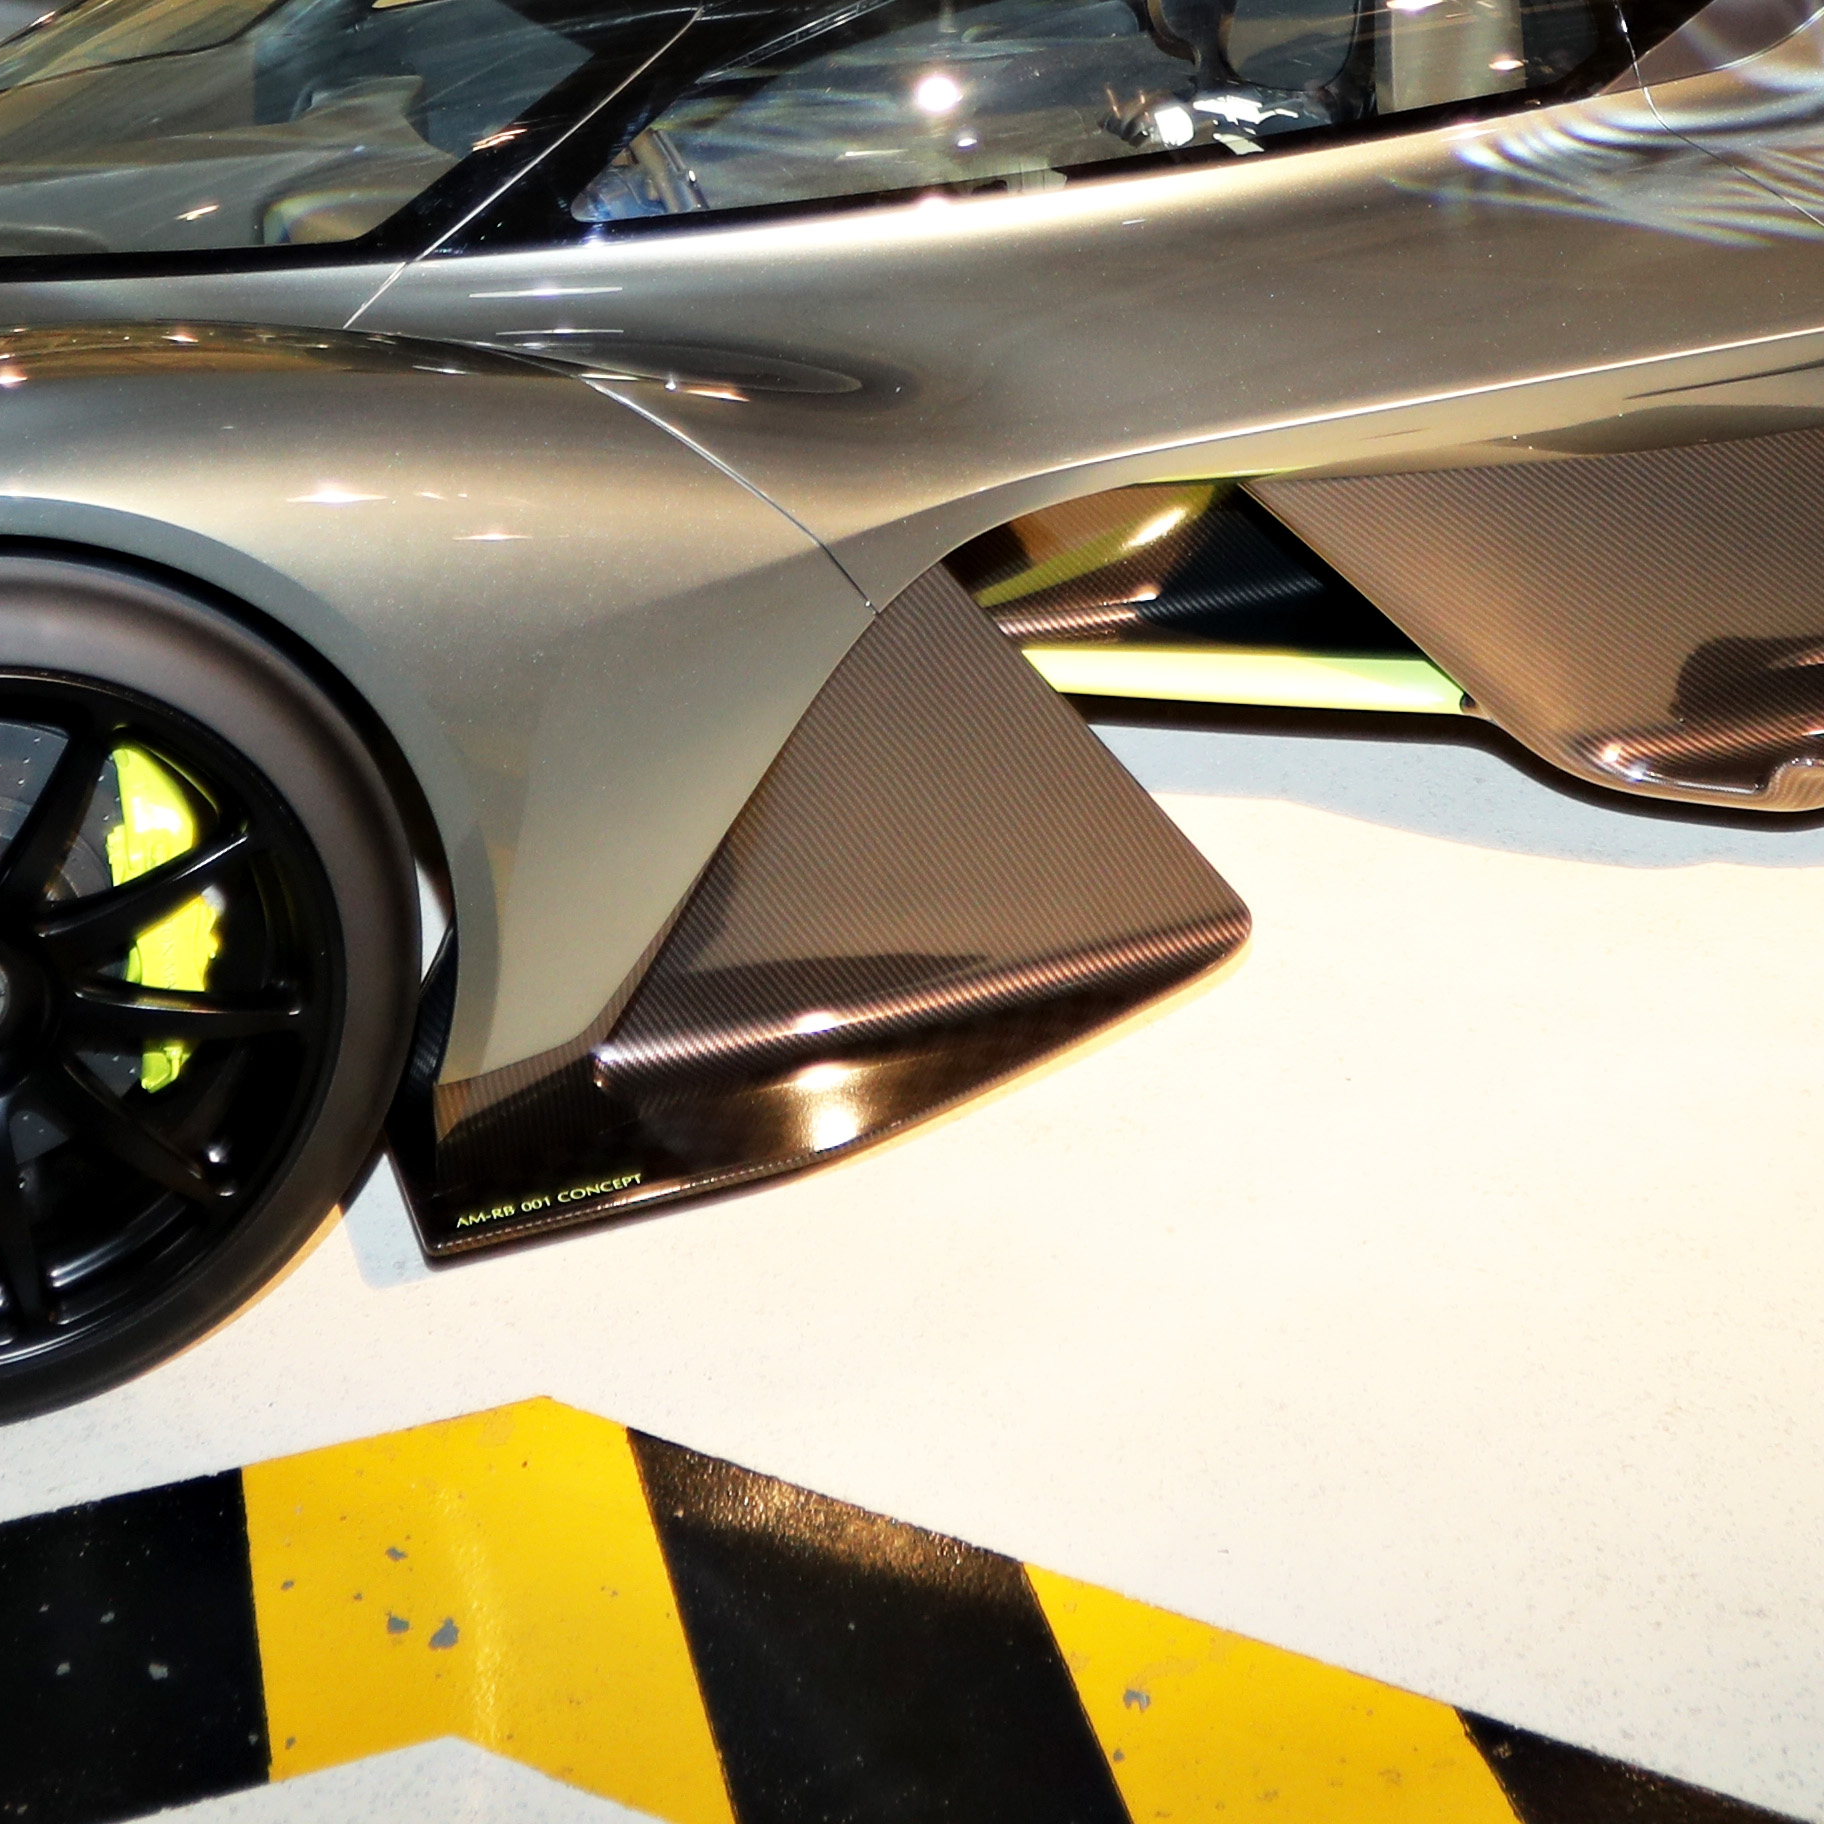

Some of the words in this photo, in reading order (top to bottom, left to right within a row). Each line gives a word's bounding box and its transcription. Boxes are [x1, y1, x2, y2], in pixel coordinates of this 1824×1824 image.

[456, 1205, 515, 1228] AM-RB
[520, 1195, 552, 1213] 001
[557, 1173, 642, 1203] CONCEPT
